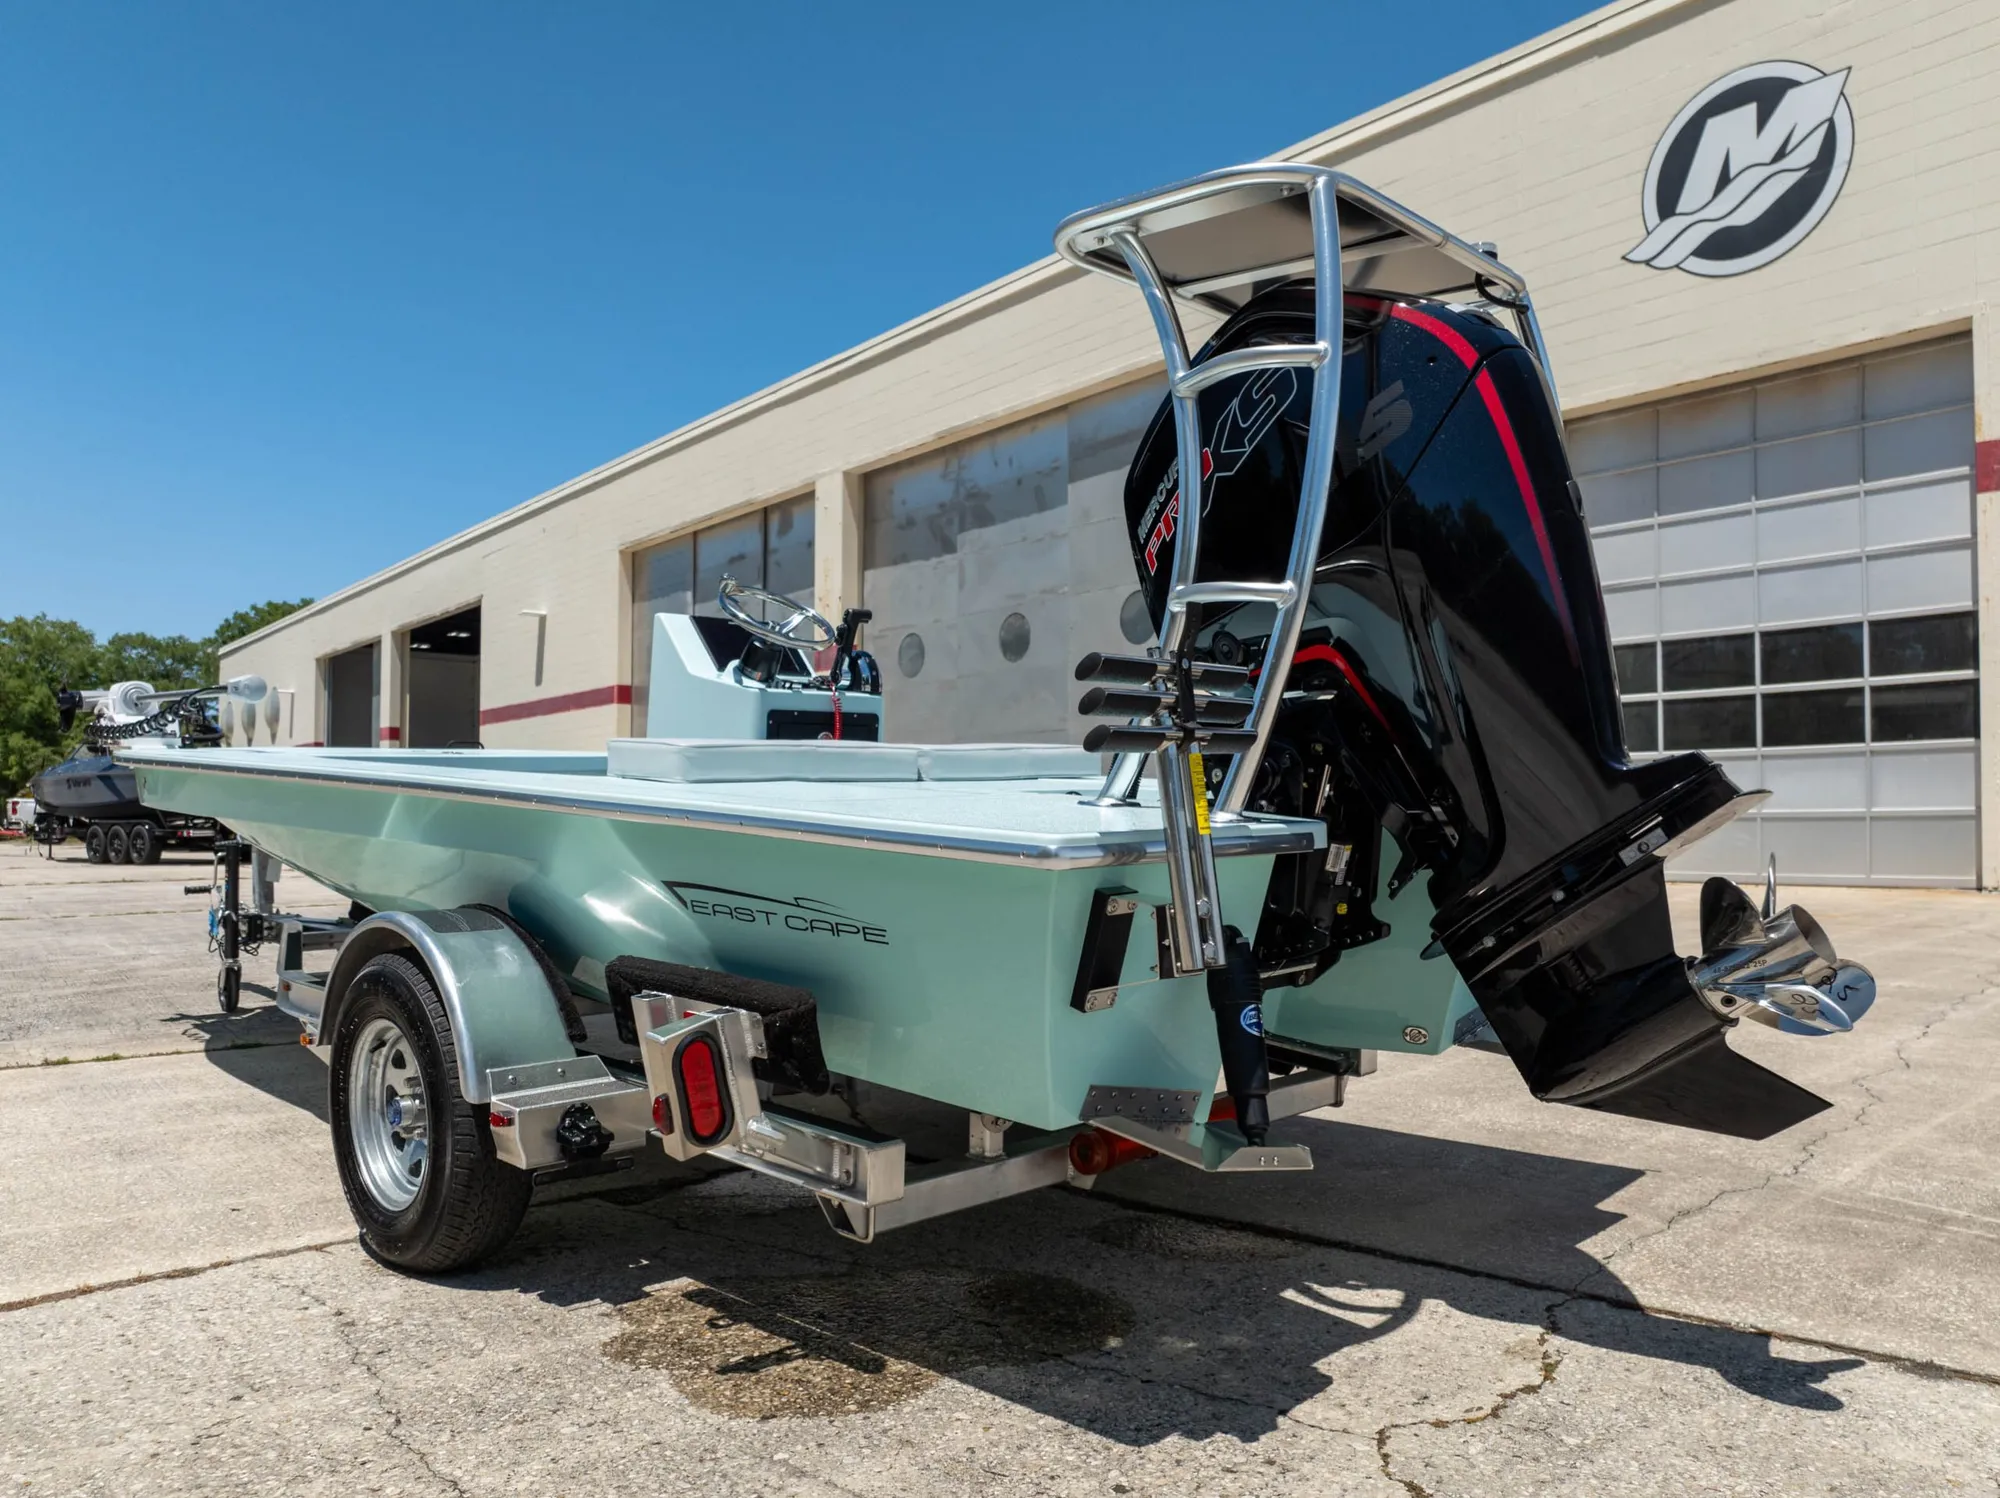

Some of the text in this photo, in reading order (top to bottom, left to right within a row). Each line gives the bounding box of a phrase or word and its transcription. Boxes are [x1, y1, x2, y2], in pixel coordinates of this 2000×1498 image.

[1137, 456, 1179, 544] MERCUR
[690, 900, 889, 945] EAST CAPE
